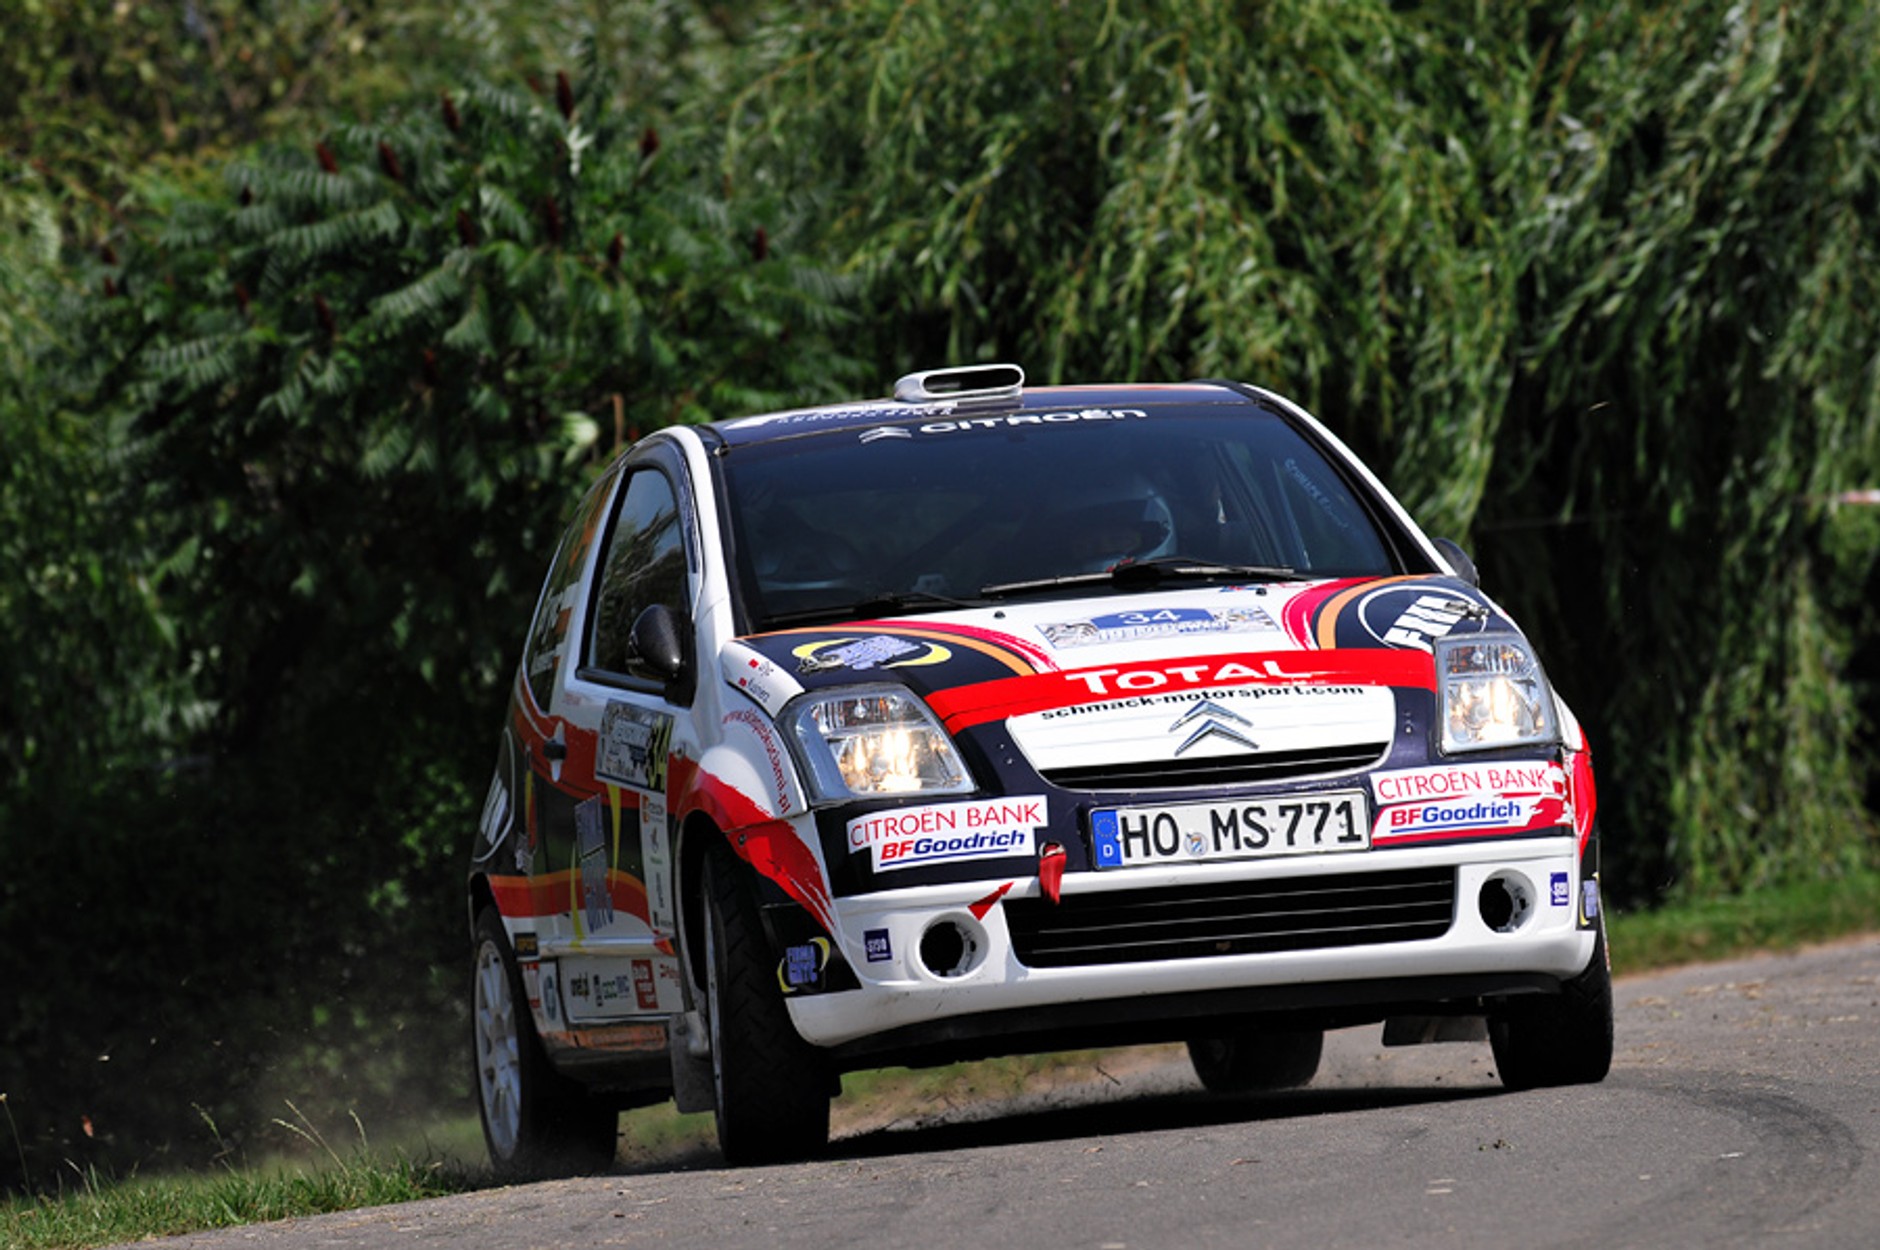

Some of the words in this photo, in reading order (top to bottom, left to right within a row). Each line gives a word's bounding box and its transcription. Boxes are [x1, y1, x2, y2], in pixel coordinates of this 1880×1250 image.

[1118, 609, 1182, 625] 34
[1065, 660, 1312, 695] TOTAL
[1042, 684, 1364, 720] schmack-motorsport.com
[1378, 767, 1482, 800] CITROËN
[1487, 767, 1551, 790] BANK
[851, 806, 956, 846] CITROËN
[967, 802, 1042, 827] BANK
[1390, 800, 1521, 826] BFGoodrich
[881, 829, 1025, 861] BFGoodrich
[1103, 845, 1113, 858] D
[1121, 812, 1180, 858] HO
